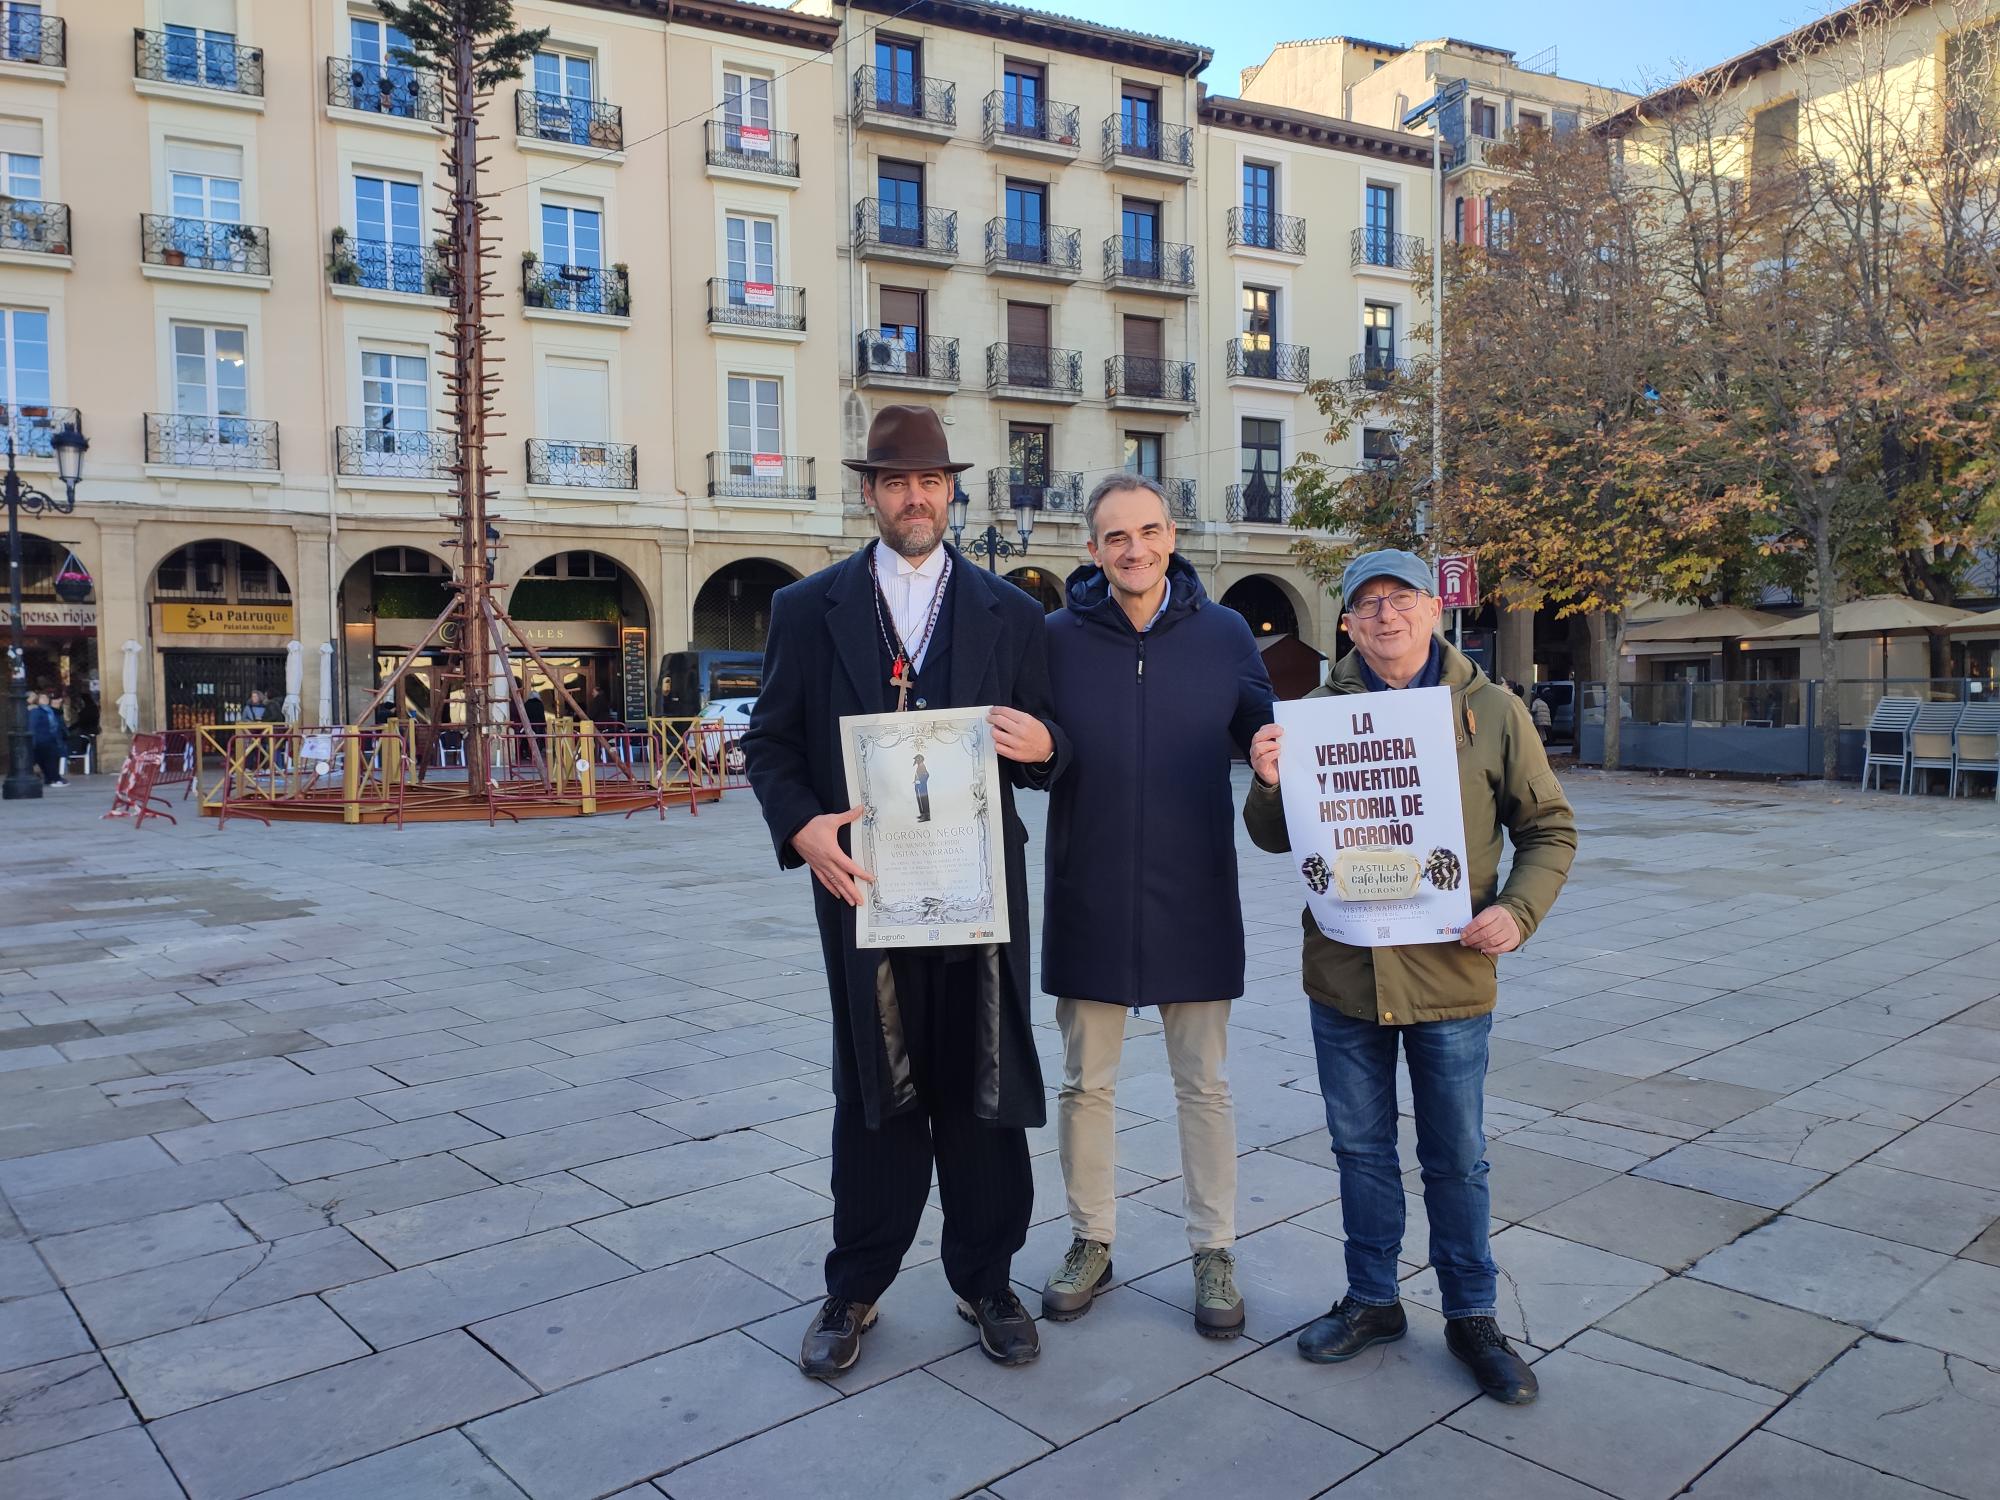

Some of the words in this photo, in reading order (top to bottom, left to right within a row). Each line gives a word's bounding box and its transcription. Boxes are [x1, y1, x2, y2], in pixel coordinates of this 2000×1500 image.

[209, 610, 223, 621] La
[227, 610, 289, 625] Patruque
[1352, 712, 1374, 736] LA
[1315, 737, 1417, 767] VERDADERA
[1316, 773, 1327, 795] Y
[1332, 765, 1421, 794] DIVERTIDA
[1318, 795, 1397, 823] HISTORIA
[1400, 793, 1424, 817] DE
[879, 829, 931, 841] LOGROÑO
[936, 826, 974, 838] NEGRO
[1333, 819, 1414, 850] LOGROÑO
[890, 850, 920, 858] VISITAS
[921, 846, 965, 857] NARRADAS
[1352, 863, 1406, 873] PASTILLAS
[1351, 873, 1375, 886] café
[1379, 873, 1409, 883] leche
[1342, 904, 1374, 914] VISITAS
[1375, 902, 1421, 912] NARRADAS
